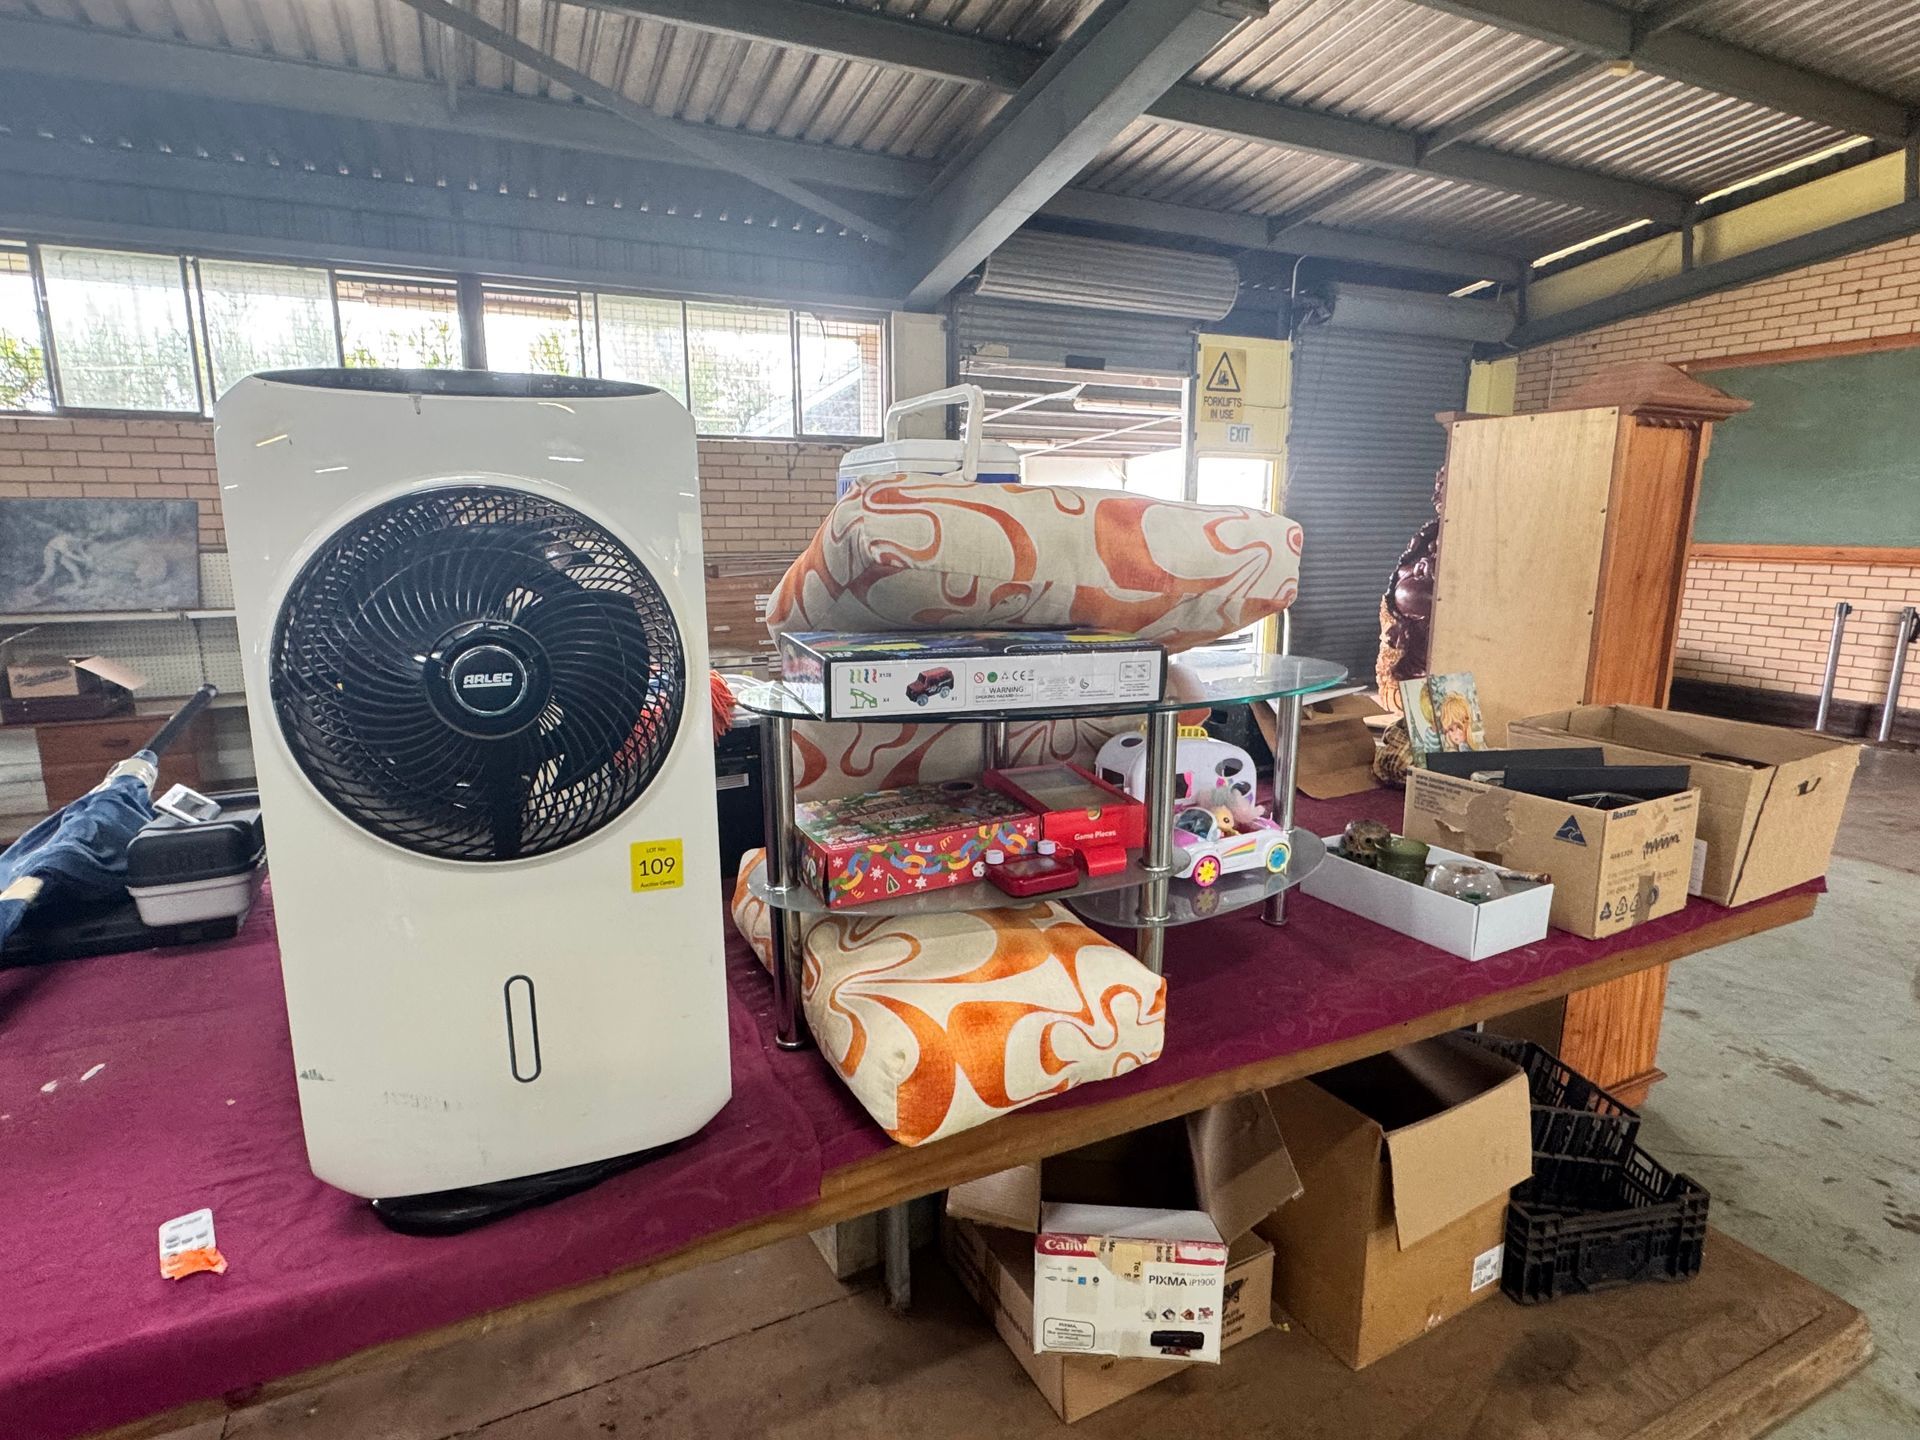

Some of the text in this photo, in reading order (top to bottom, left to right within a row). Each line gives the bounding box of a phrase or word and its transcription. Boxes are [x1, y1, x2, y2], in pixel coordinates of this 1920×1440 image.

[1203, 396, 1242, 408] FORKLIFTS
[1210, 409, 1234, 420] IN USE
[1230, 426, 1250, 443] EXIT
[463, 672, 513, 685] ARLEC
[989, 686, 1024, 694] WARNING
[1094, 830, 1116, 838] Pieces
[639, 856, 676, 876] 109
[1148, 1275, 1188, 1286] PIXMA
[1189, 1278, 1216, 1286] iP1900
